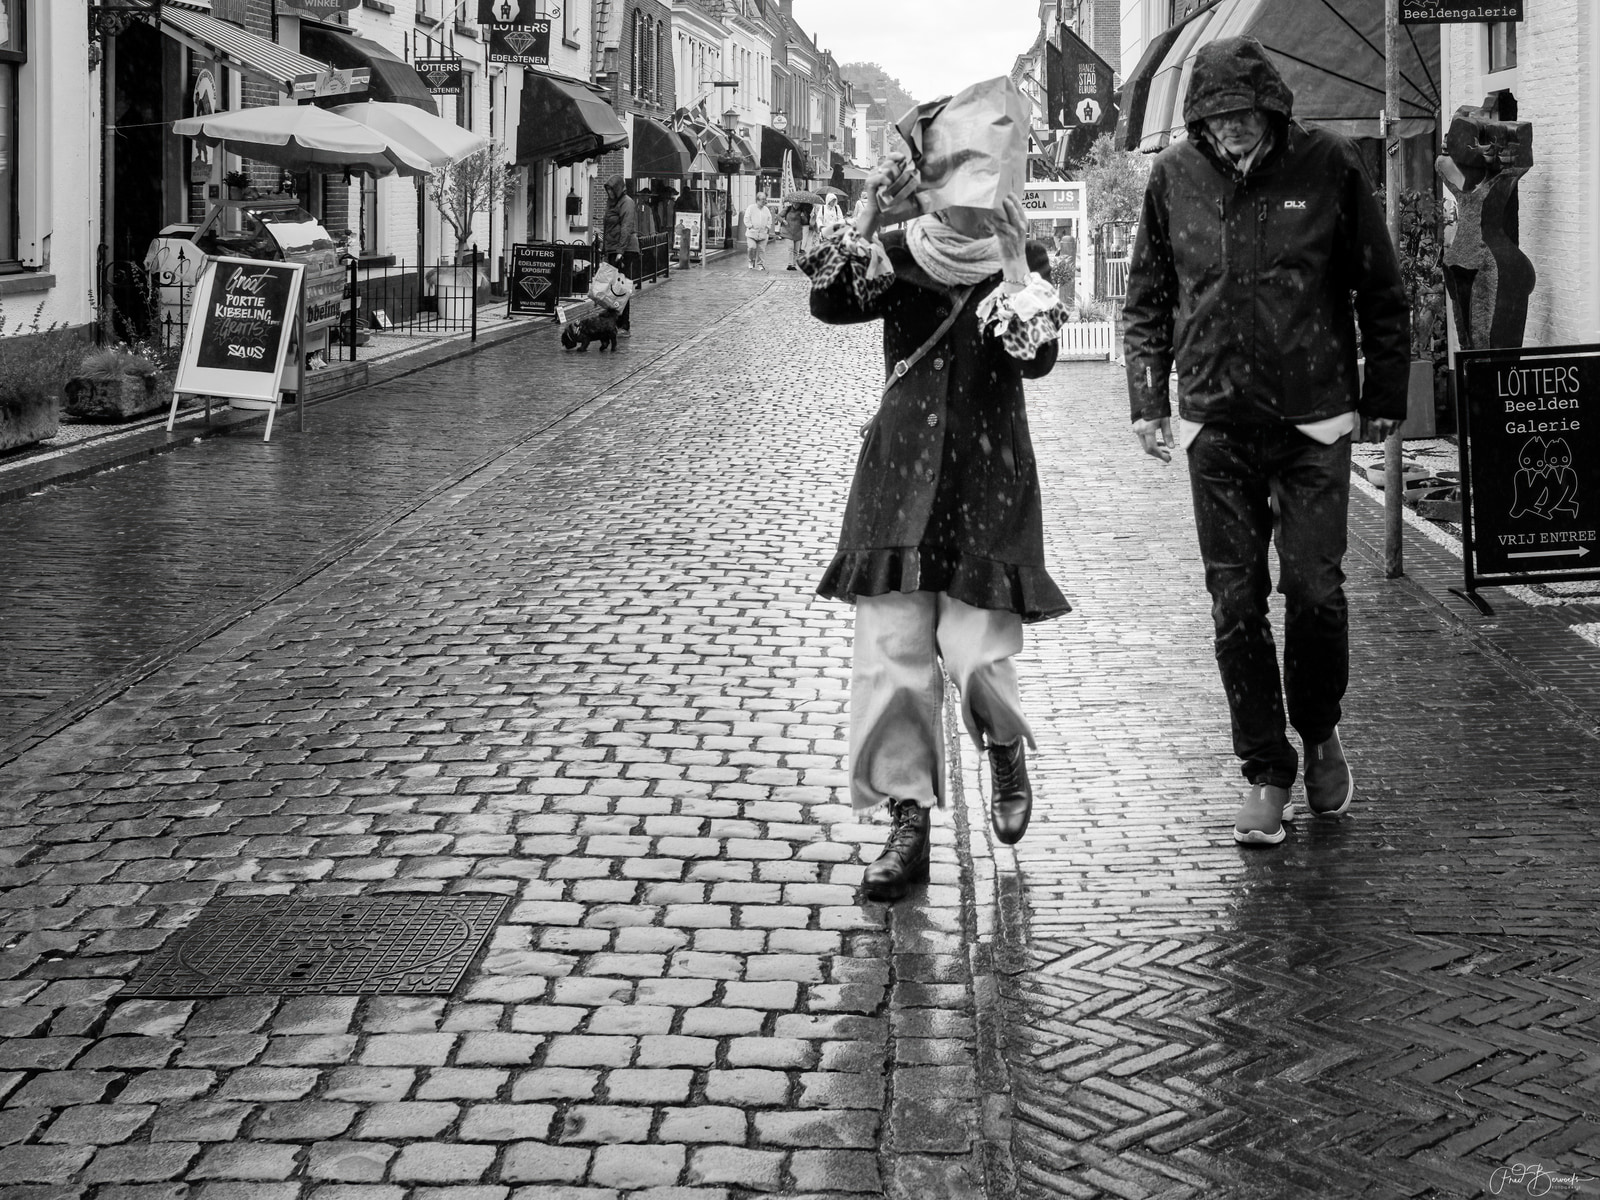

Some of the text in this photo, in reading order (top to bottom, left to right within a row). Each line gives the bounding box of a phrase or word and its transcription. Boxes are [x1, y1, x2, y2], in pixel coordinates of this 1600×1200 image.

[1404, 6, 1518, 20] Beeldengalerie
[491, 54, 547, 64] EDELSTENEN
[1078, 72, 1097, 86] STAD
[1022, 190, 1075, 203] ASA IJS
[1284, 200, 1306, 209] DLX
[225, 293, 266, 307] PORTIE
[219, 318, 264, 339] GRATIS
[227, 344, 266, 359] SAUS
[1498, 366, 1580, 397] LÖTTERS
[1504, 396, 1580, 413] Beelden
[1505, 417, 1581, 434] Galerie
[1497, 530, 1597, 546] VRIJ ENTREE
